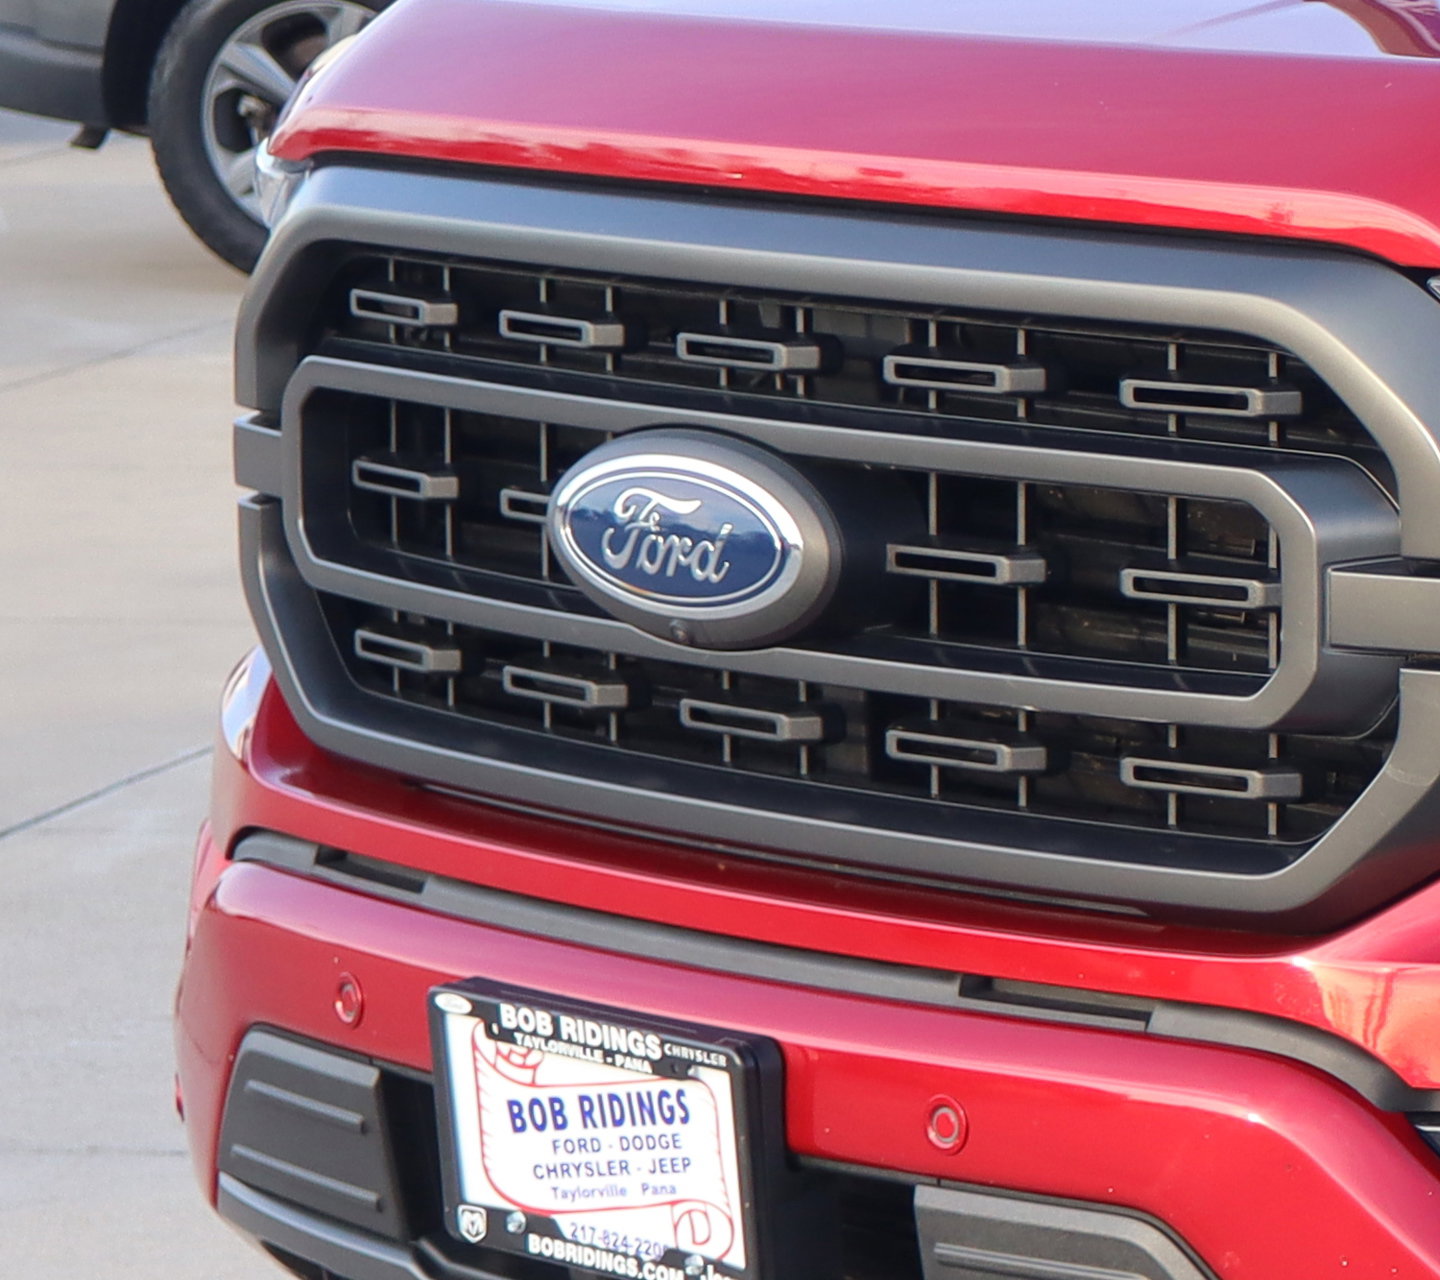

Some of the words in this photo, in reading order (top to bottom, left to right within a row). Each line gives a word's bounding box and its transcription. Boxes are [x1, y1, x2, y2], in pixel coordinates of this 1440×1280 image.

[602, 487, 732, 583] Ford
[500, 1003, 554, 1037] BOB
[559, 1015, 663, 1061] RIDINGS
[663, 1043, 727, 1068] CHRYSLER
[614, 1053, 653, 1074] PANA
[506, 1097, 569, 1134] BOB
[577, 1088, 690, 1130] RIDINGS
[552, 1137, 602, 1155] FORD
[619, 1132, 682, 1151] DODGE
[532, 1159, 631, 1180] CHRYSLER
[649, 1156, 692, 1175] JEEP
[552, 1183, 628, 1203] Taylorville
[641, 1181, 677, 1196] Pana
